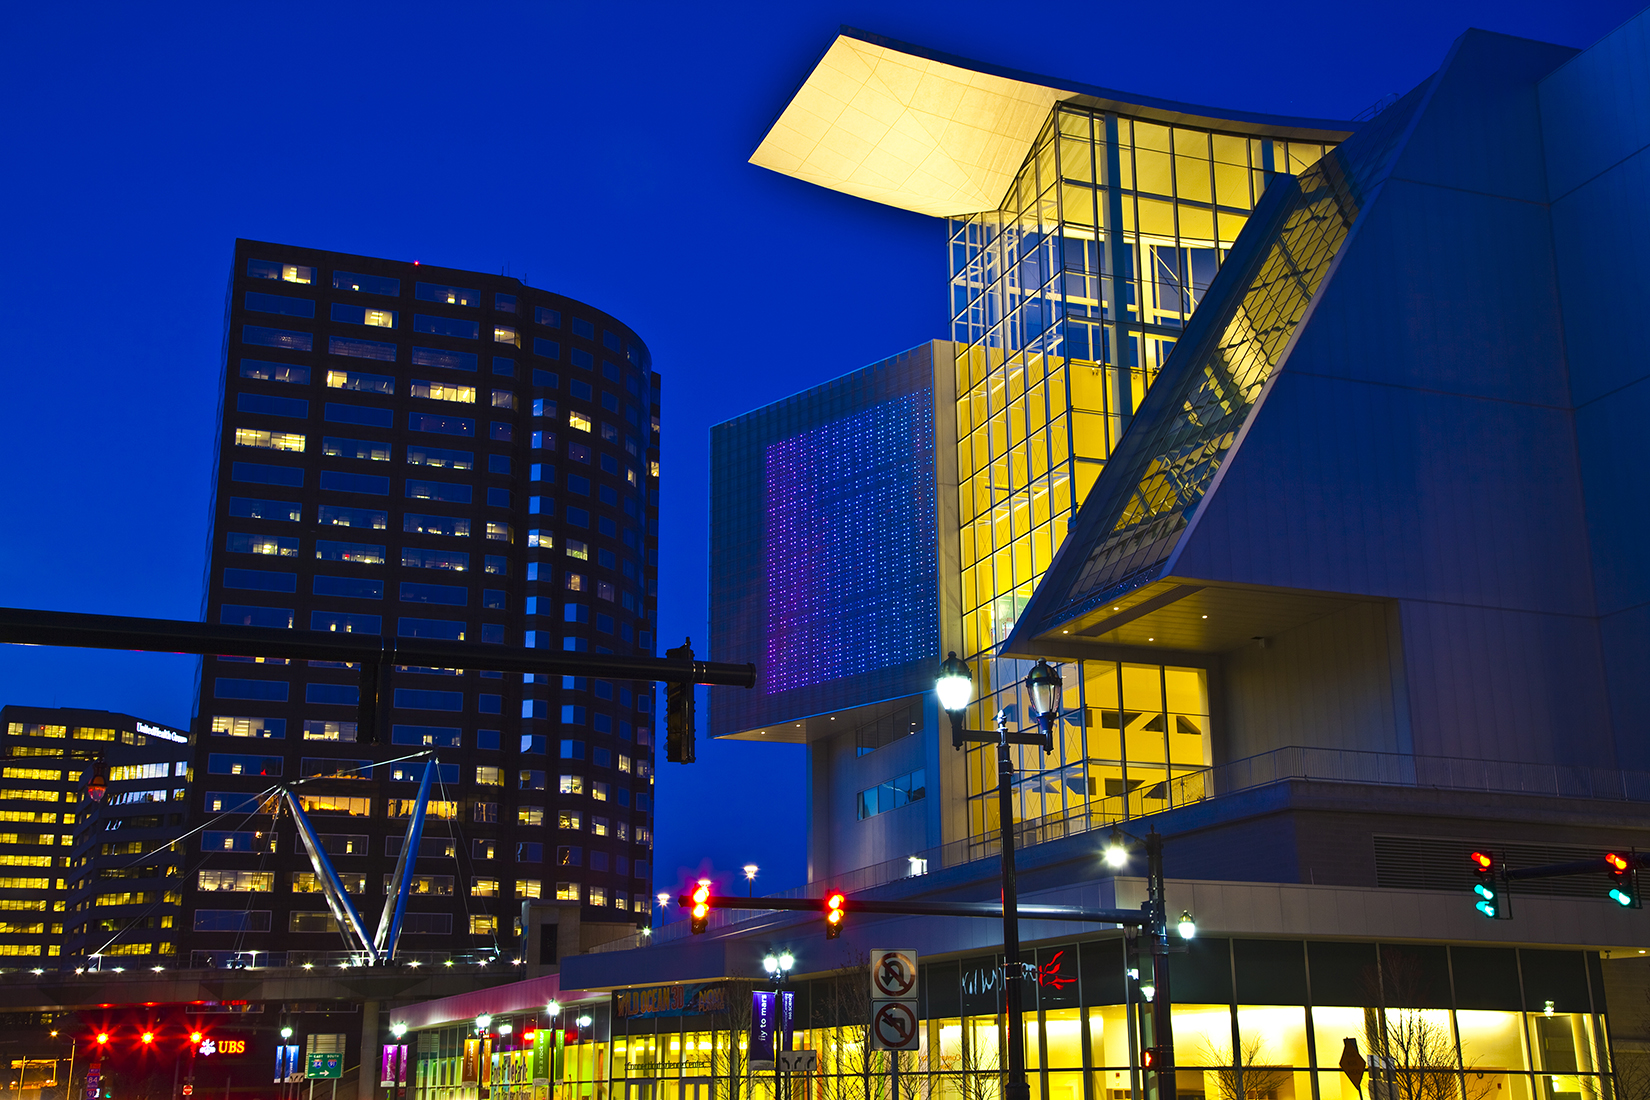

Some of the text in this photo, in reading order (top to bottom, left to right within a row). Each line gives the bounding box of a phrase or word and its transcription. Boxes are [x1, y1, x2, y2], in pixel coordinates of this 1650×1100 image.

[617, 985, 684, 1016] WILD OCEAN 3D
[698, 987, 725, 1003] NOW
[760, 1018, 766, 1028] to
[758, 1030, 768, 1041] fly
[218, 1040, 245, 1054] UBS
[537, 1066, 543, 1075] be
[88, 1076, 98, 1084] 84
